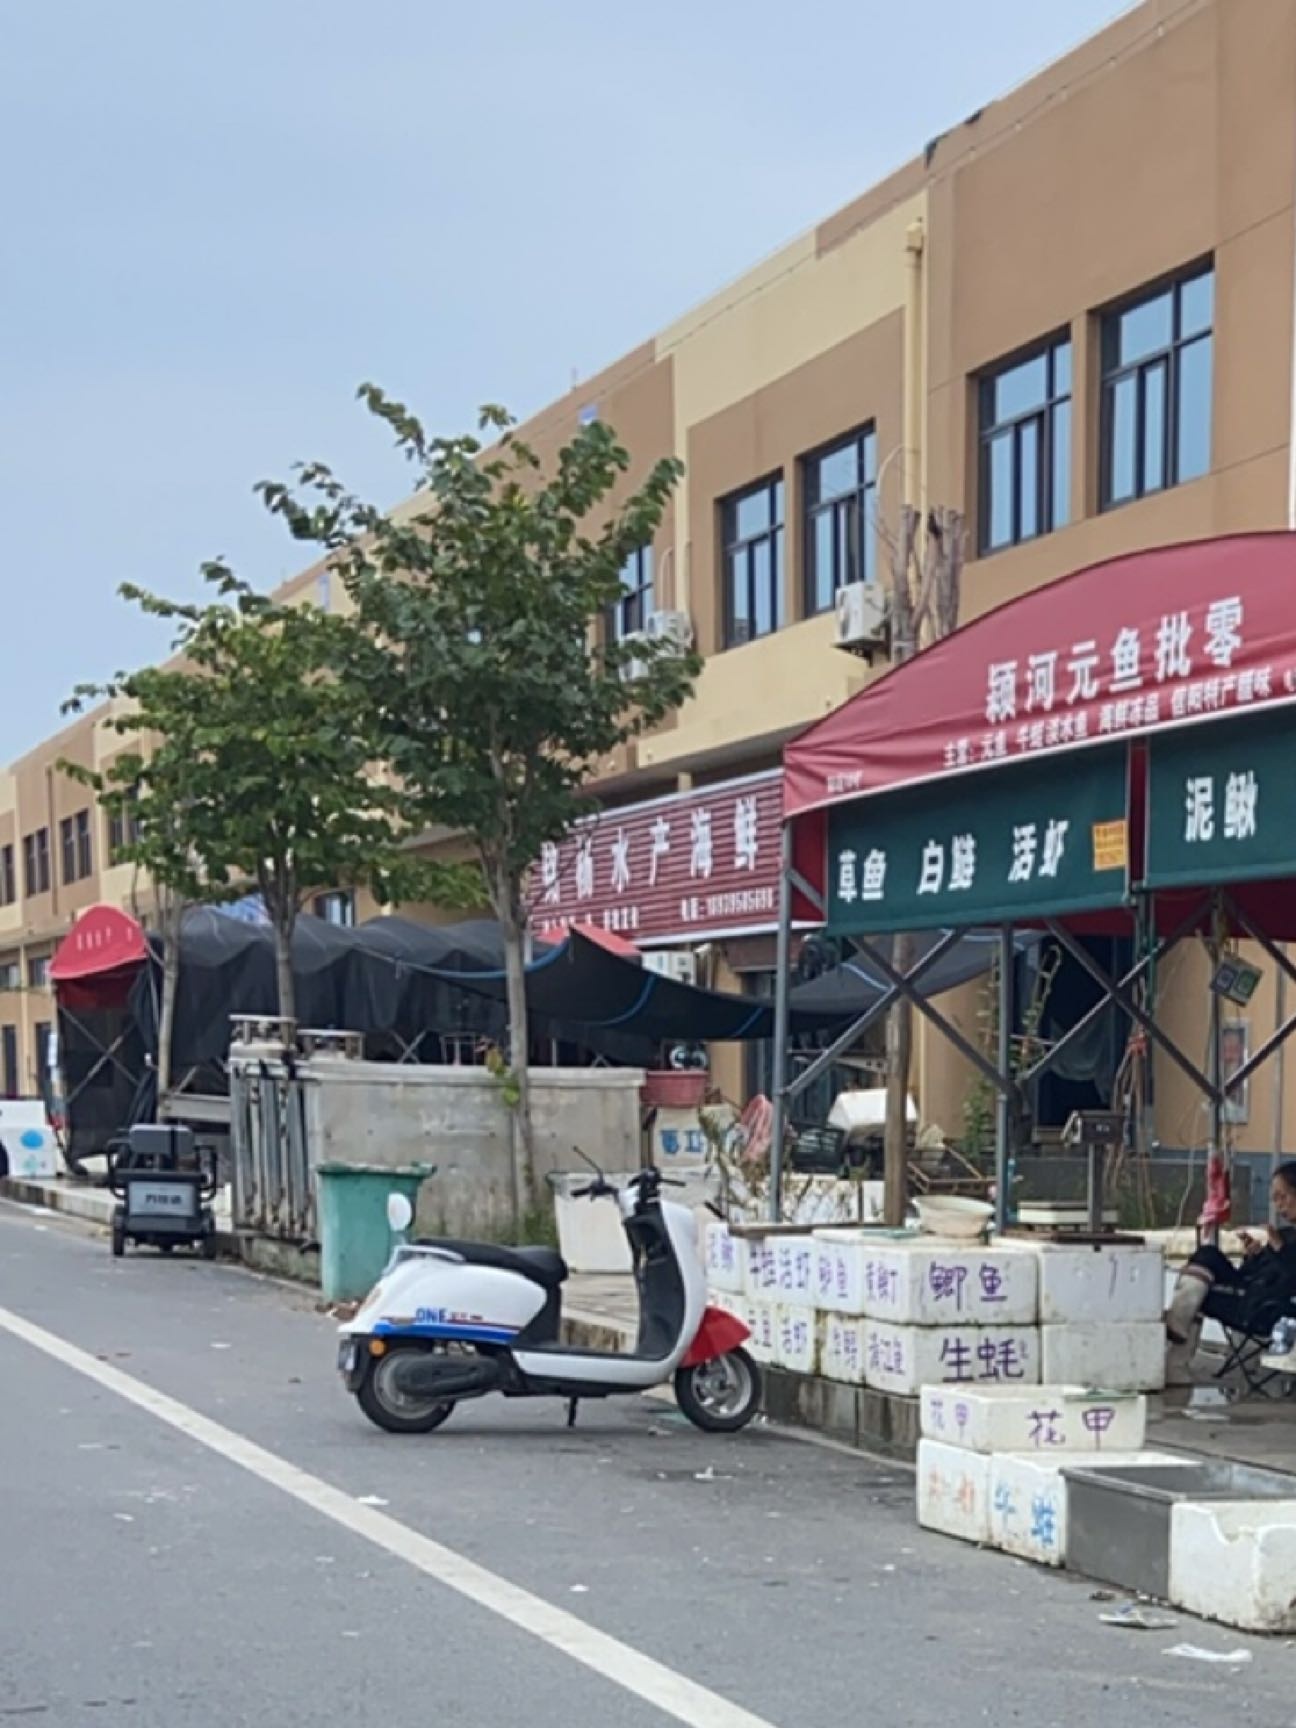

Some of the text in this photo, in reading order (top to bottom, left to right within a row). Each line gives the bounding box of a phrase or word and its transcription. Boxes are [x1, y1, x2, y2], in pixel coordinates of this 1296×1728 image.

[929, 1260, 1008, 1312] 鲫鱼
[415, 1308, 448, 1322] ONE
[938, 1336, 1025, 1382] 生蚝
[1026, 1405, 1116, 1450] 花甲
